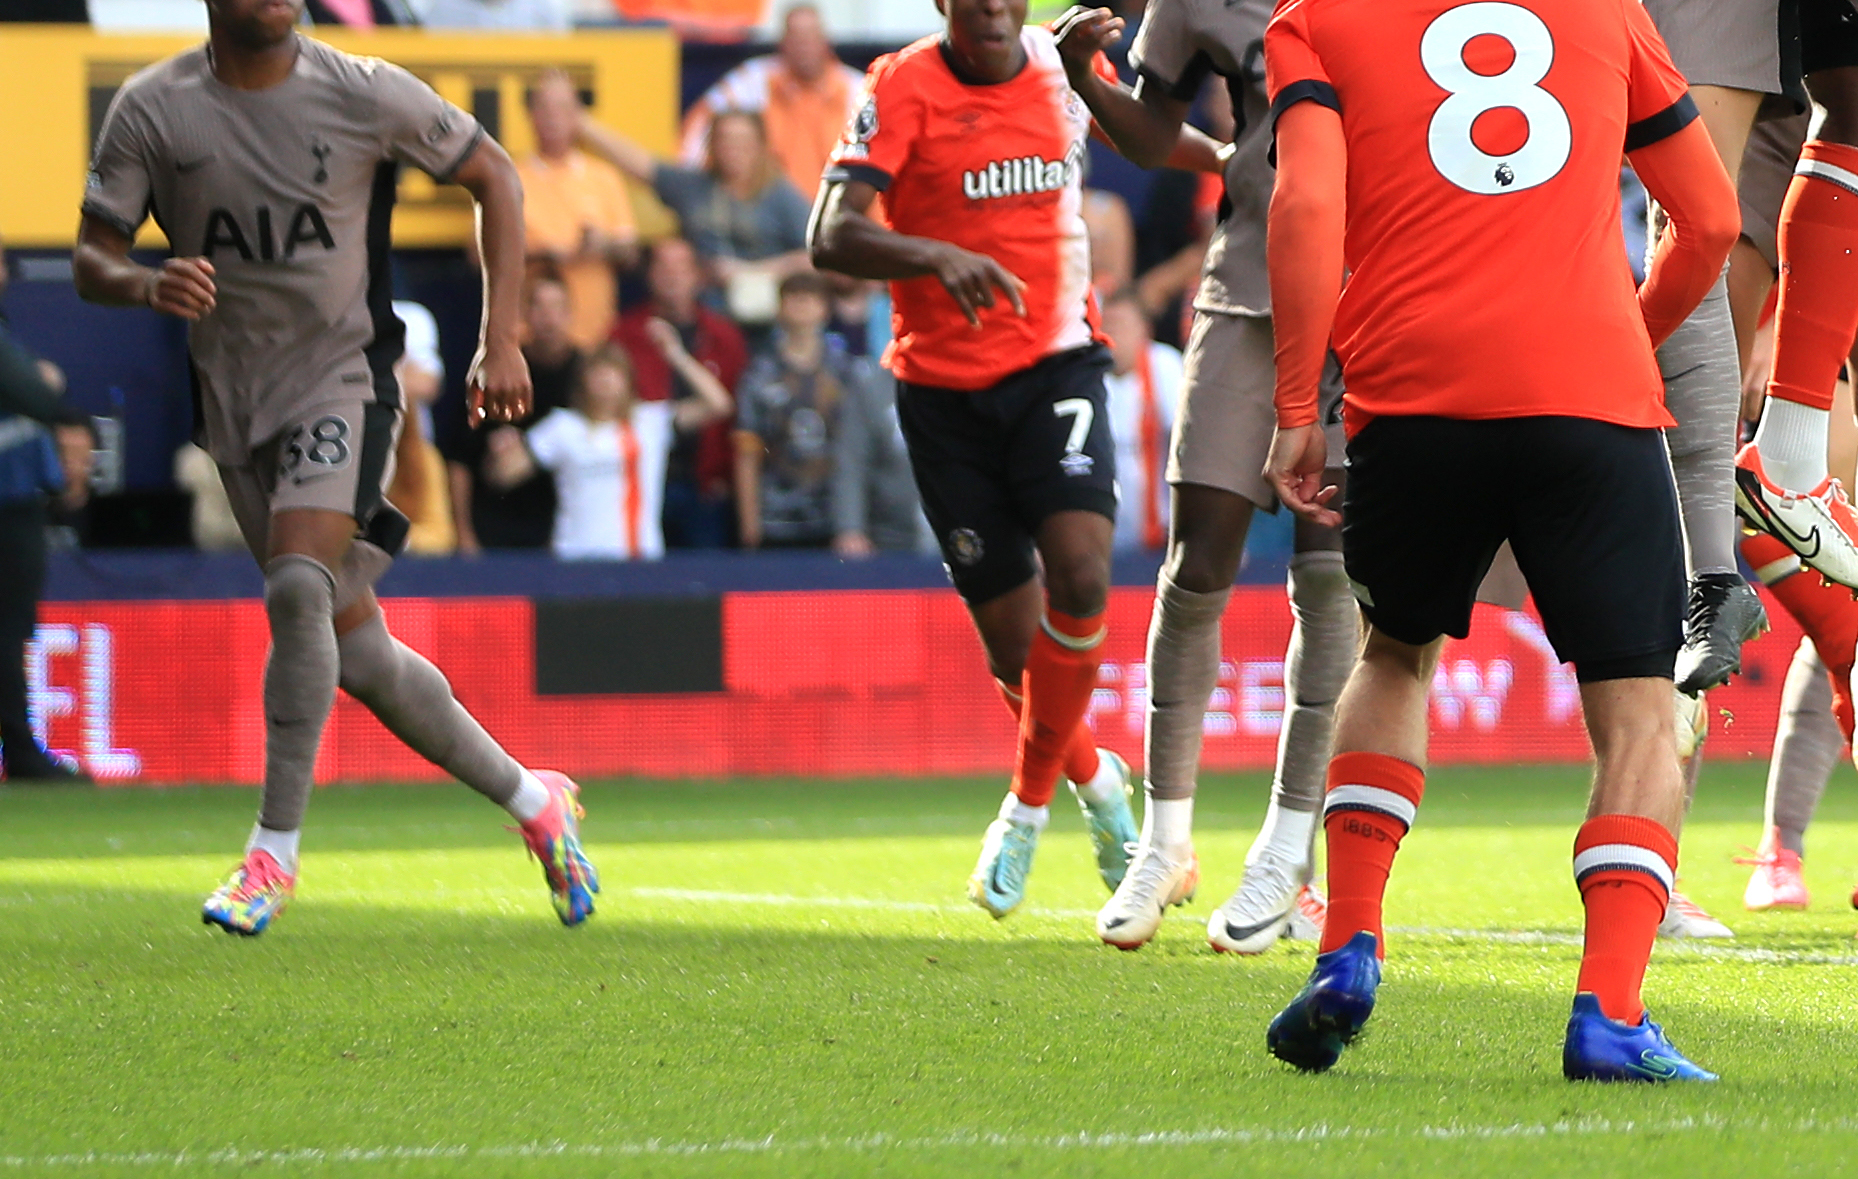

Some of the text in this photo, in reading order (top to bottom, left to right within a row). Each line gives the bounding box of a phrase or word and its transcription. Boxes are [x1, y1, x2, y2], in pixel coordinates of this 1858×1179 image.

[1420, 0, 1572, 195] 8
[964, 151, 1066, 200] utilita
[202, 201, 336, 262] AIA
[1052, 397, 1095, 453] 7
[1343, 817, 1388, 842] 1885
